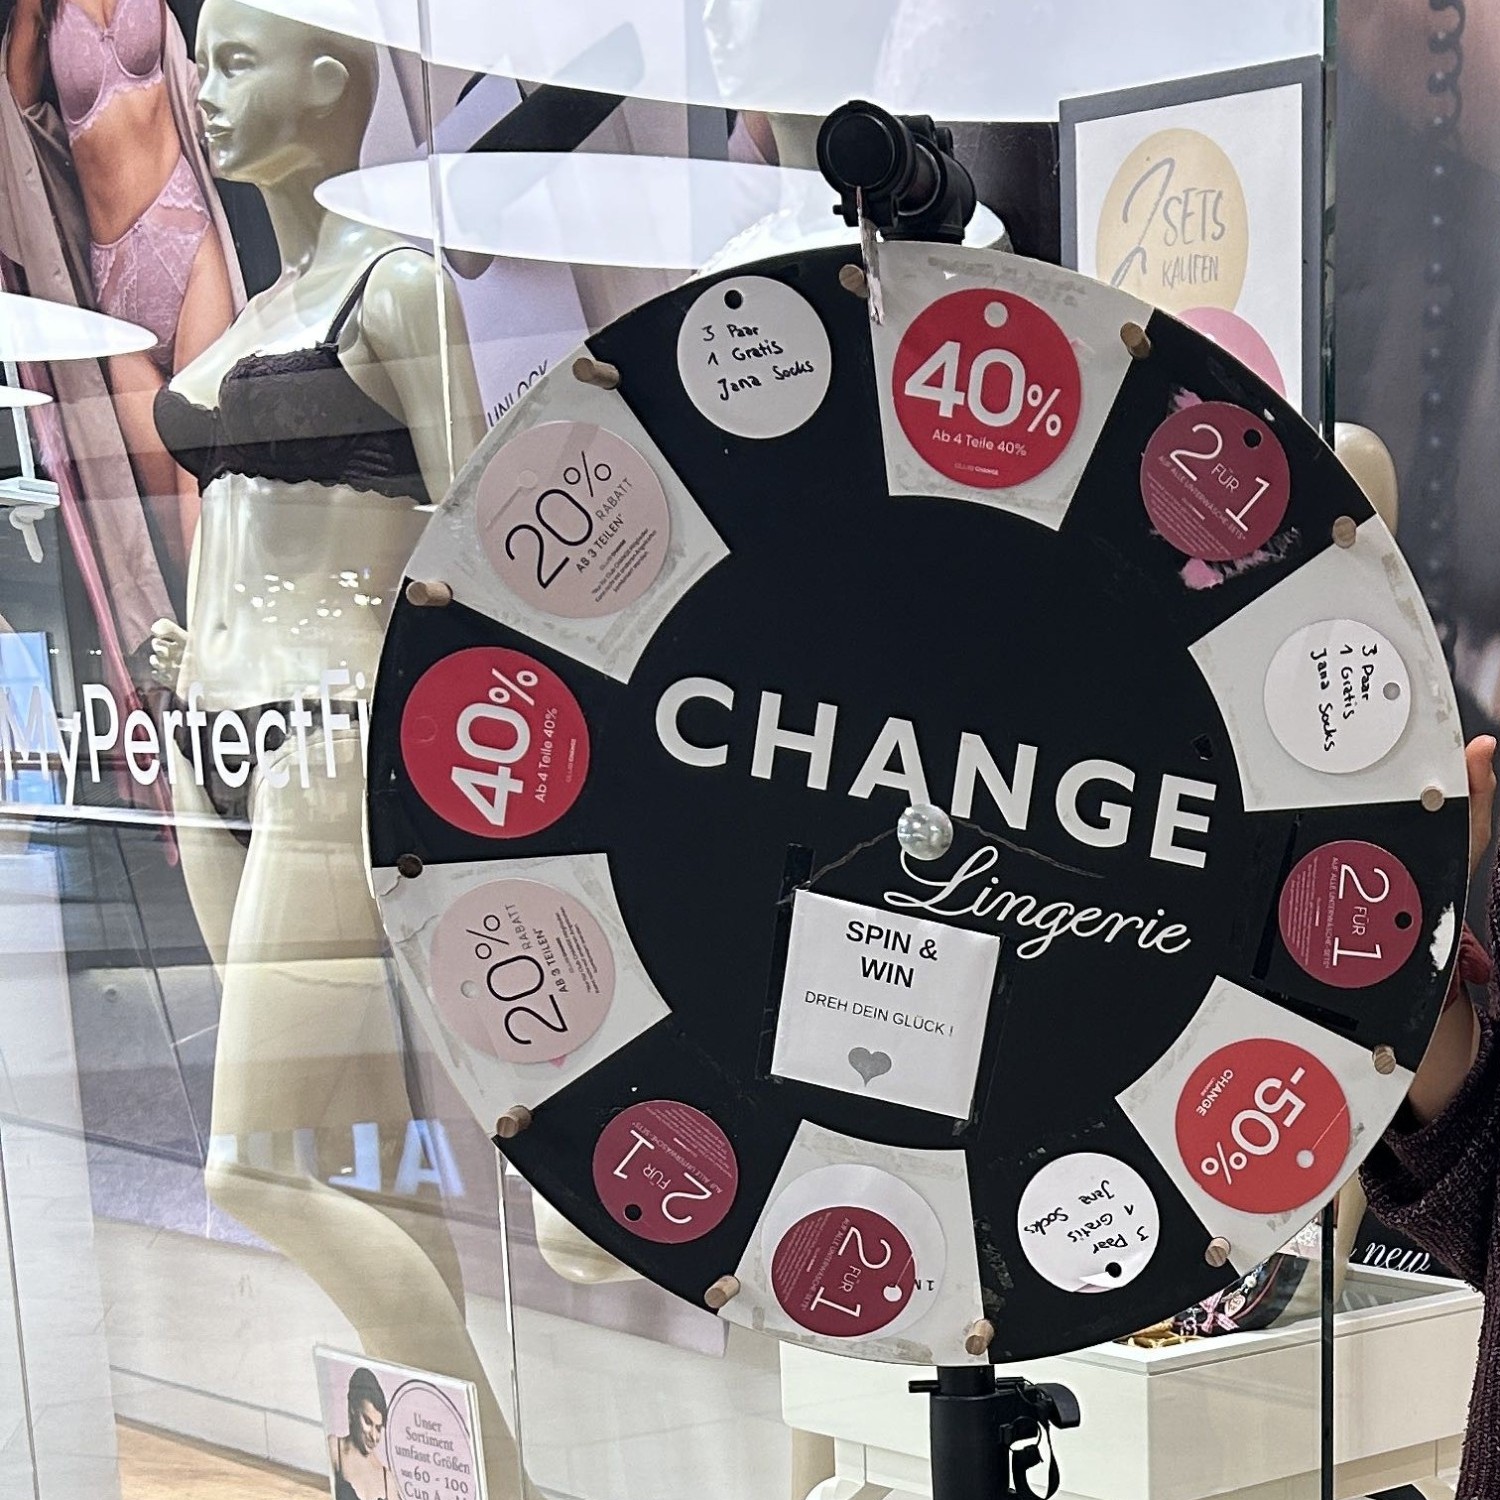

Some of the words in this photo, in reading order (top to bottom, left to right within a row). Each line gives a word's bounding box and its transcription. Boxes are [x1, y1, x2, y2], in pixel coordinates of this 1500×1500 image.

[1162, 187, 1226, 247] SETS
[1162, 254, 1219, 289] KAUFEN
[702, 325, 715, 341] 3
[727, 324, 759, 338] Paar
[732, 340, 783, 360] Gratis
[717, 376, 761, 401] Jana
[773, 361, 814, 380] Socks
[905, 340, 1062, 437] 40%
[932, 429, 951, 442] Ab
[953, 433, 963, 445] 4
[965, 434, 995, 451] Teile
[997, 441, 1027, 456] 40%
[1169, 424, 1223, 482] 2
[1211, 463, 1240, 494] FÜR
[595, 477, 633, 521] RABATT
[1225, 476, 1270, 532] 1
[505, 451, 611, 589] 20%
[576, 558, 591, 573] AB
[588, 548, 599, 559] 3
[1362, 644, 1378, 657] 3
[1310, 648, 1330, 690] Jana
[1361, 664, 1375, 701] Paar
[1341, 666, 1358, 720] Gratis
[543, 707, 558, 738] 40%
[451, 668, 538, 827] 40%
[539, 741, 553, 769] Teile
[537, 773, 549, 786] 4
[655, 677, 1217, 869] CHANGE
[535, 785, 546, 803] Ab
[1339, 864, 1390, 903] 2
[884, 845, 1191, 960] Lingerie
[505, 904, 531, 950] RABATT
[1352, 906, 1370, 936] FÜR
[845, 919, 912, 956] SPIN
[919, 938, 939, 961] &
[1333, 937, 1382, 966] 1
[466, 914, 568, 1045] 20%
[551, 968, 560, 976] 3
[555, 978, 568, 994] AB
[860, 956, 915, 989] WIN
[804, 991, 848, 1013] DREH
[852, 1002, 890, 1024] DEIN
[892, 1010, 946, 1037] GLÜCK
[948, 1023, 954, 1037] !
[1196, 1069, 1234, 1117] CHANGE
[1201, 1066, 1306, 1185] -50%
[613, 1130, 655, 1179] 1
[643, 1164, 672, 1190] FÜR
[1078, 1180, 1115, 1204] Jana
[662, 1172, 712, 1224] 2
[1067, 1213, 1113, 1242] Gratis
[1136, 1226, 1149, 1241] 3
[838, 1226, 891, 1269] 2
[1093, 1234, 1128, 1254] Paar
[1363, 1242, 1431, 1274] new
[839, 1265, 861, 1292] FÜR
[810, 1287, 861, 1317] 1
[413, 1412, 442, 1432] Unser
[405, 1426, 454, 1451] Sortiment
[433, 1452, 470, 1475] Größen
[414, 1466, 430, 1483] 60
[445, 1477, 468, 1494] 100
